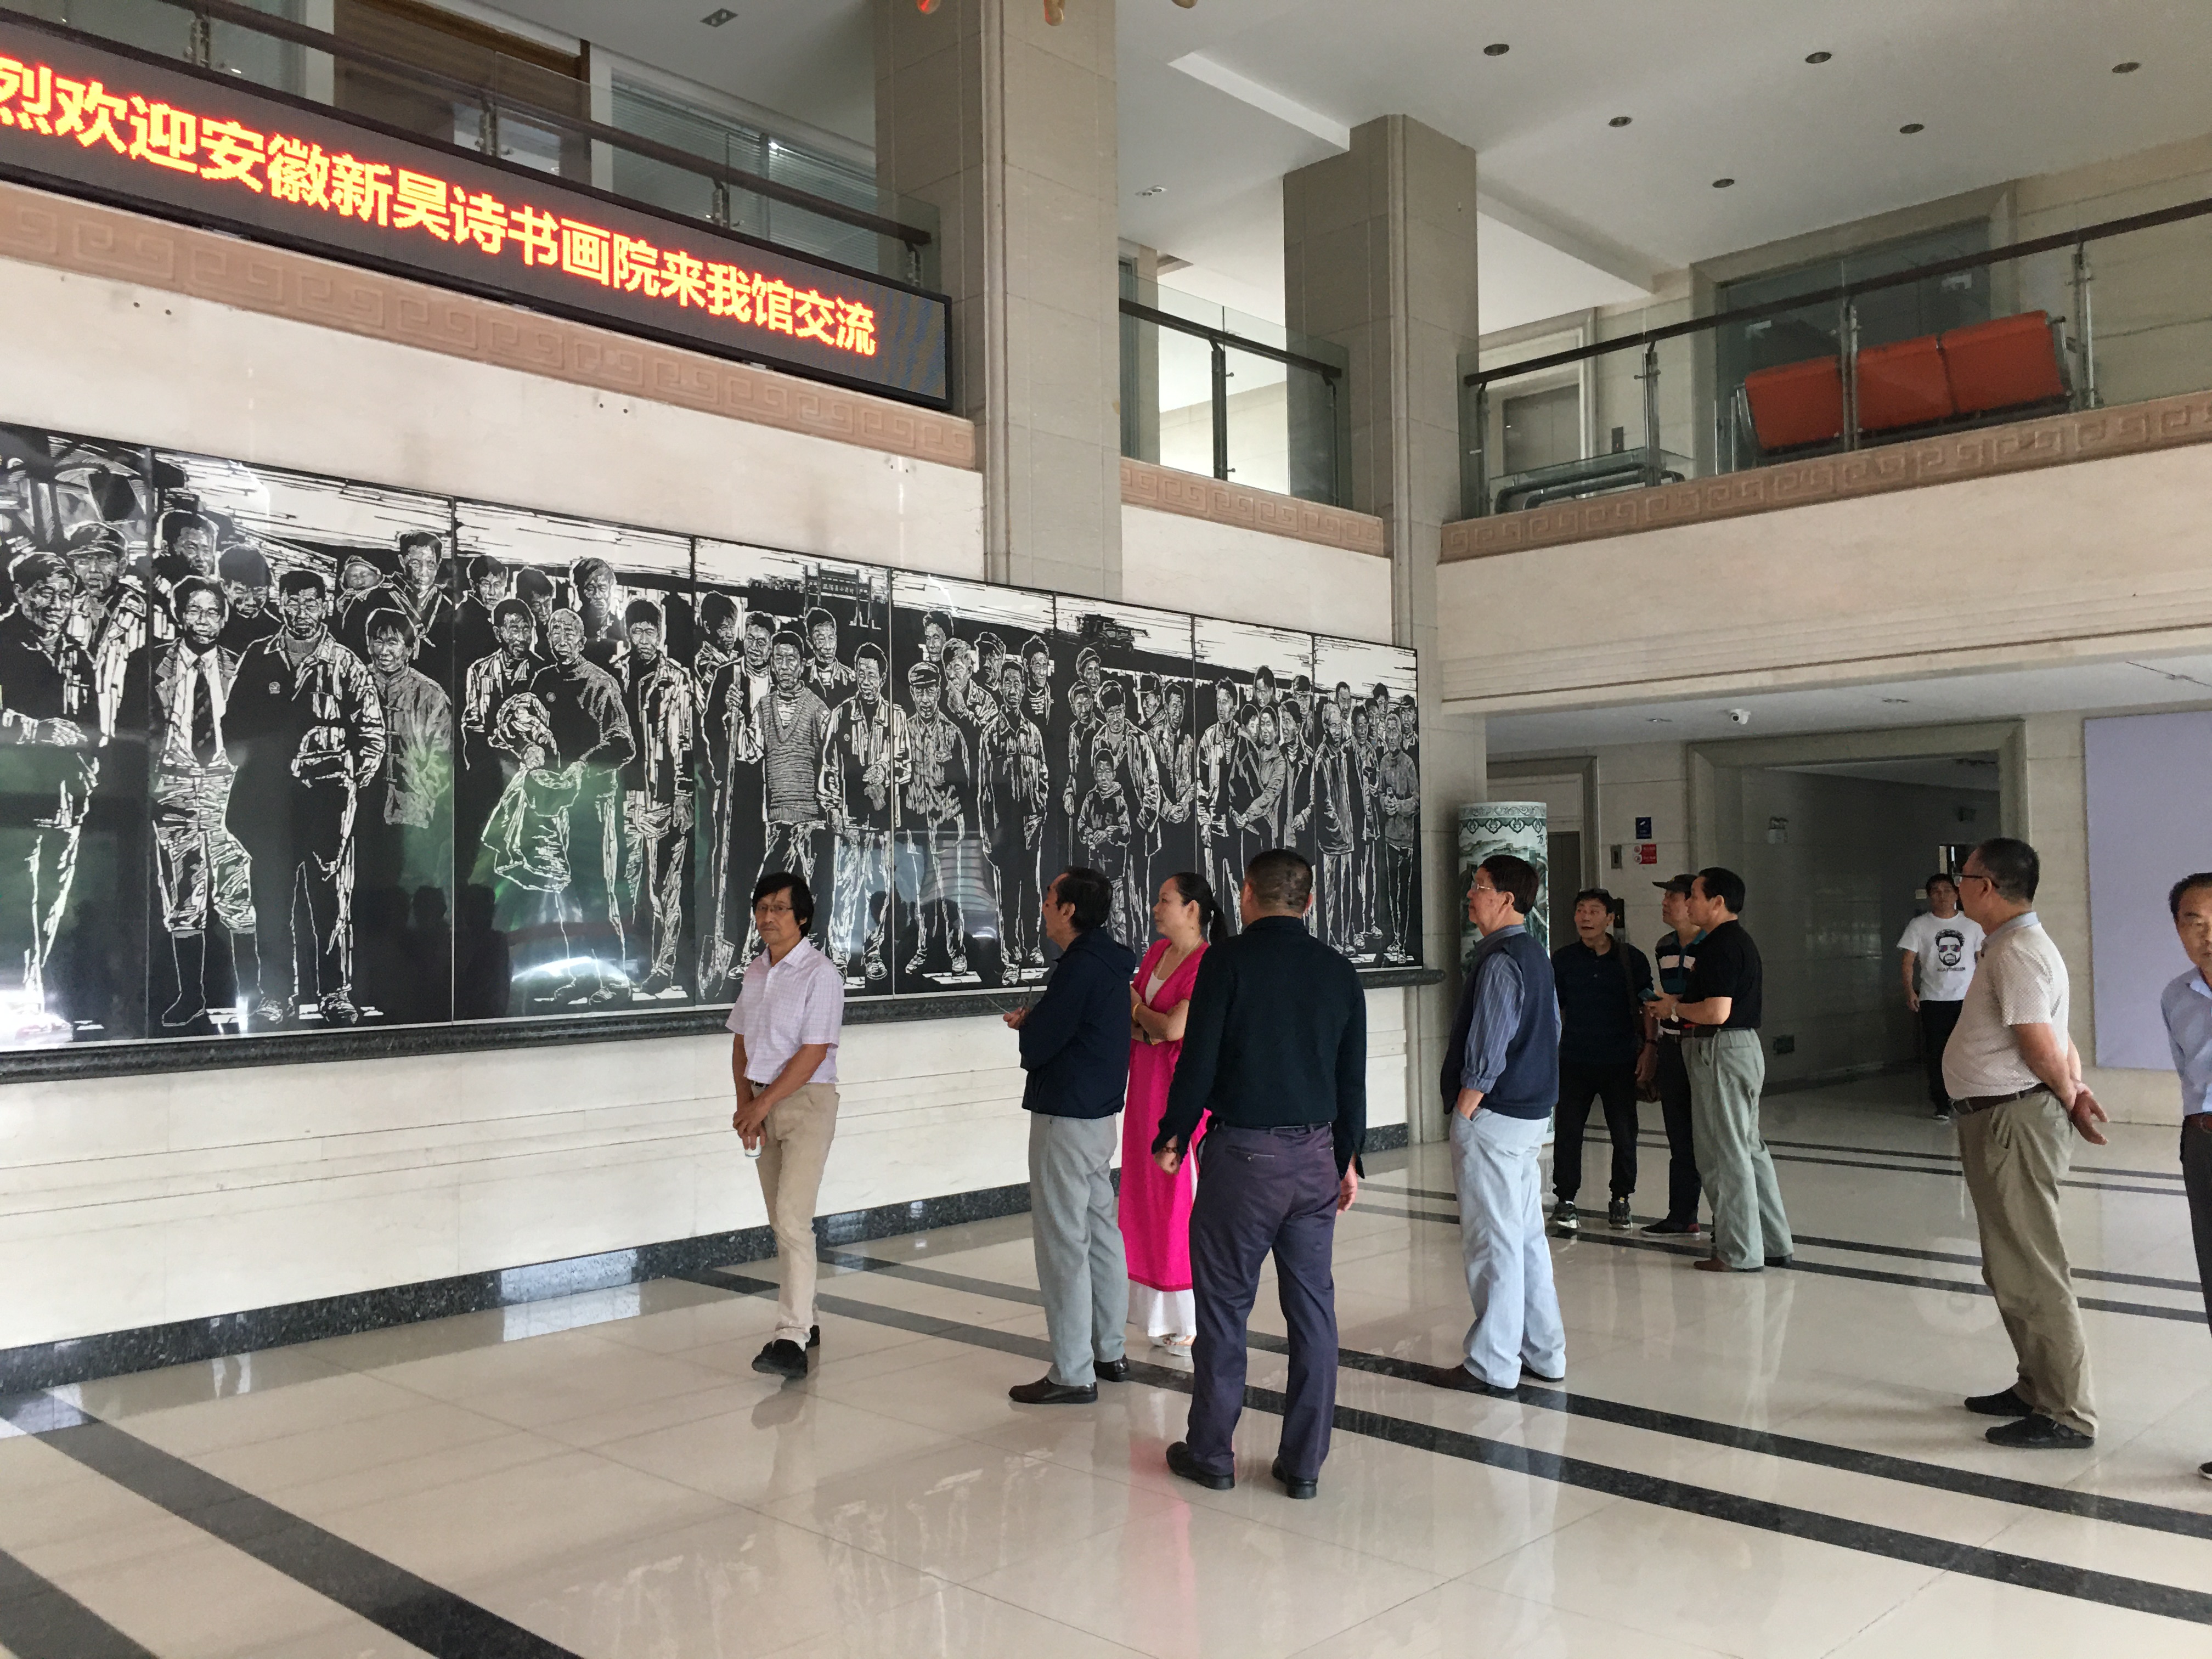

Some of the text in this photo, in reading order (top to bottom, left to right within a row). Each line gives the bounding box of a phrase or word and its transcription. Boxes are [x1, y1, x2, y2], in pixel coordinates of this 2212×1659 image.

[0, 57, 877, 356] 烈欢迎安徽新昊诗书画院来我馆交流
